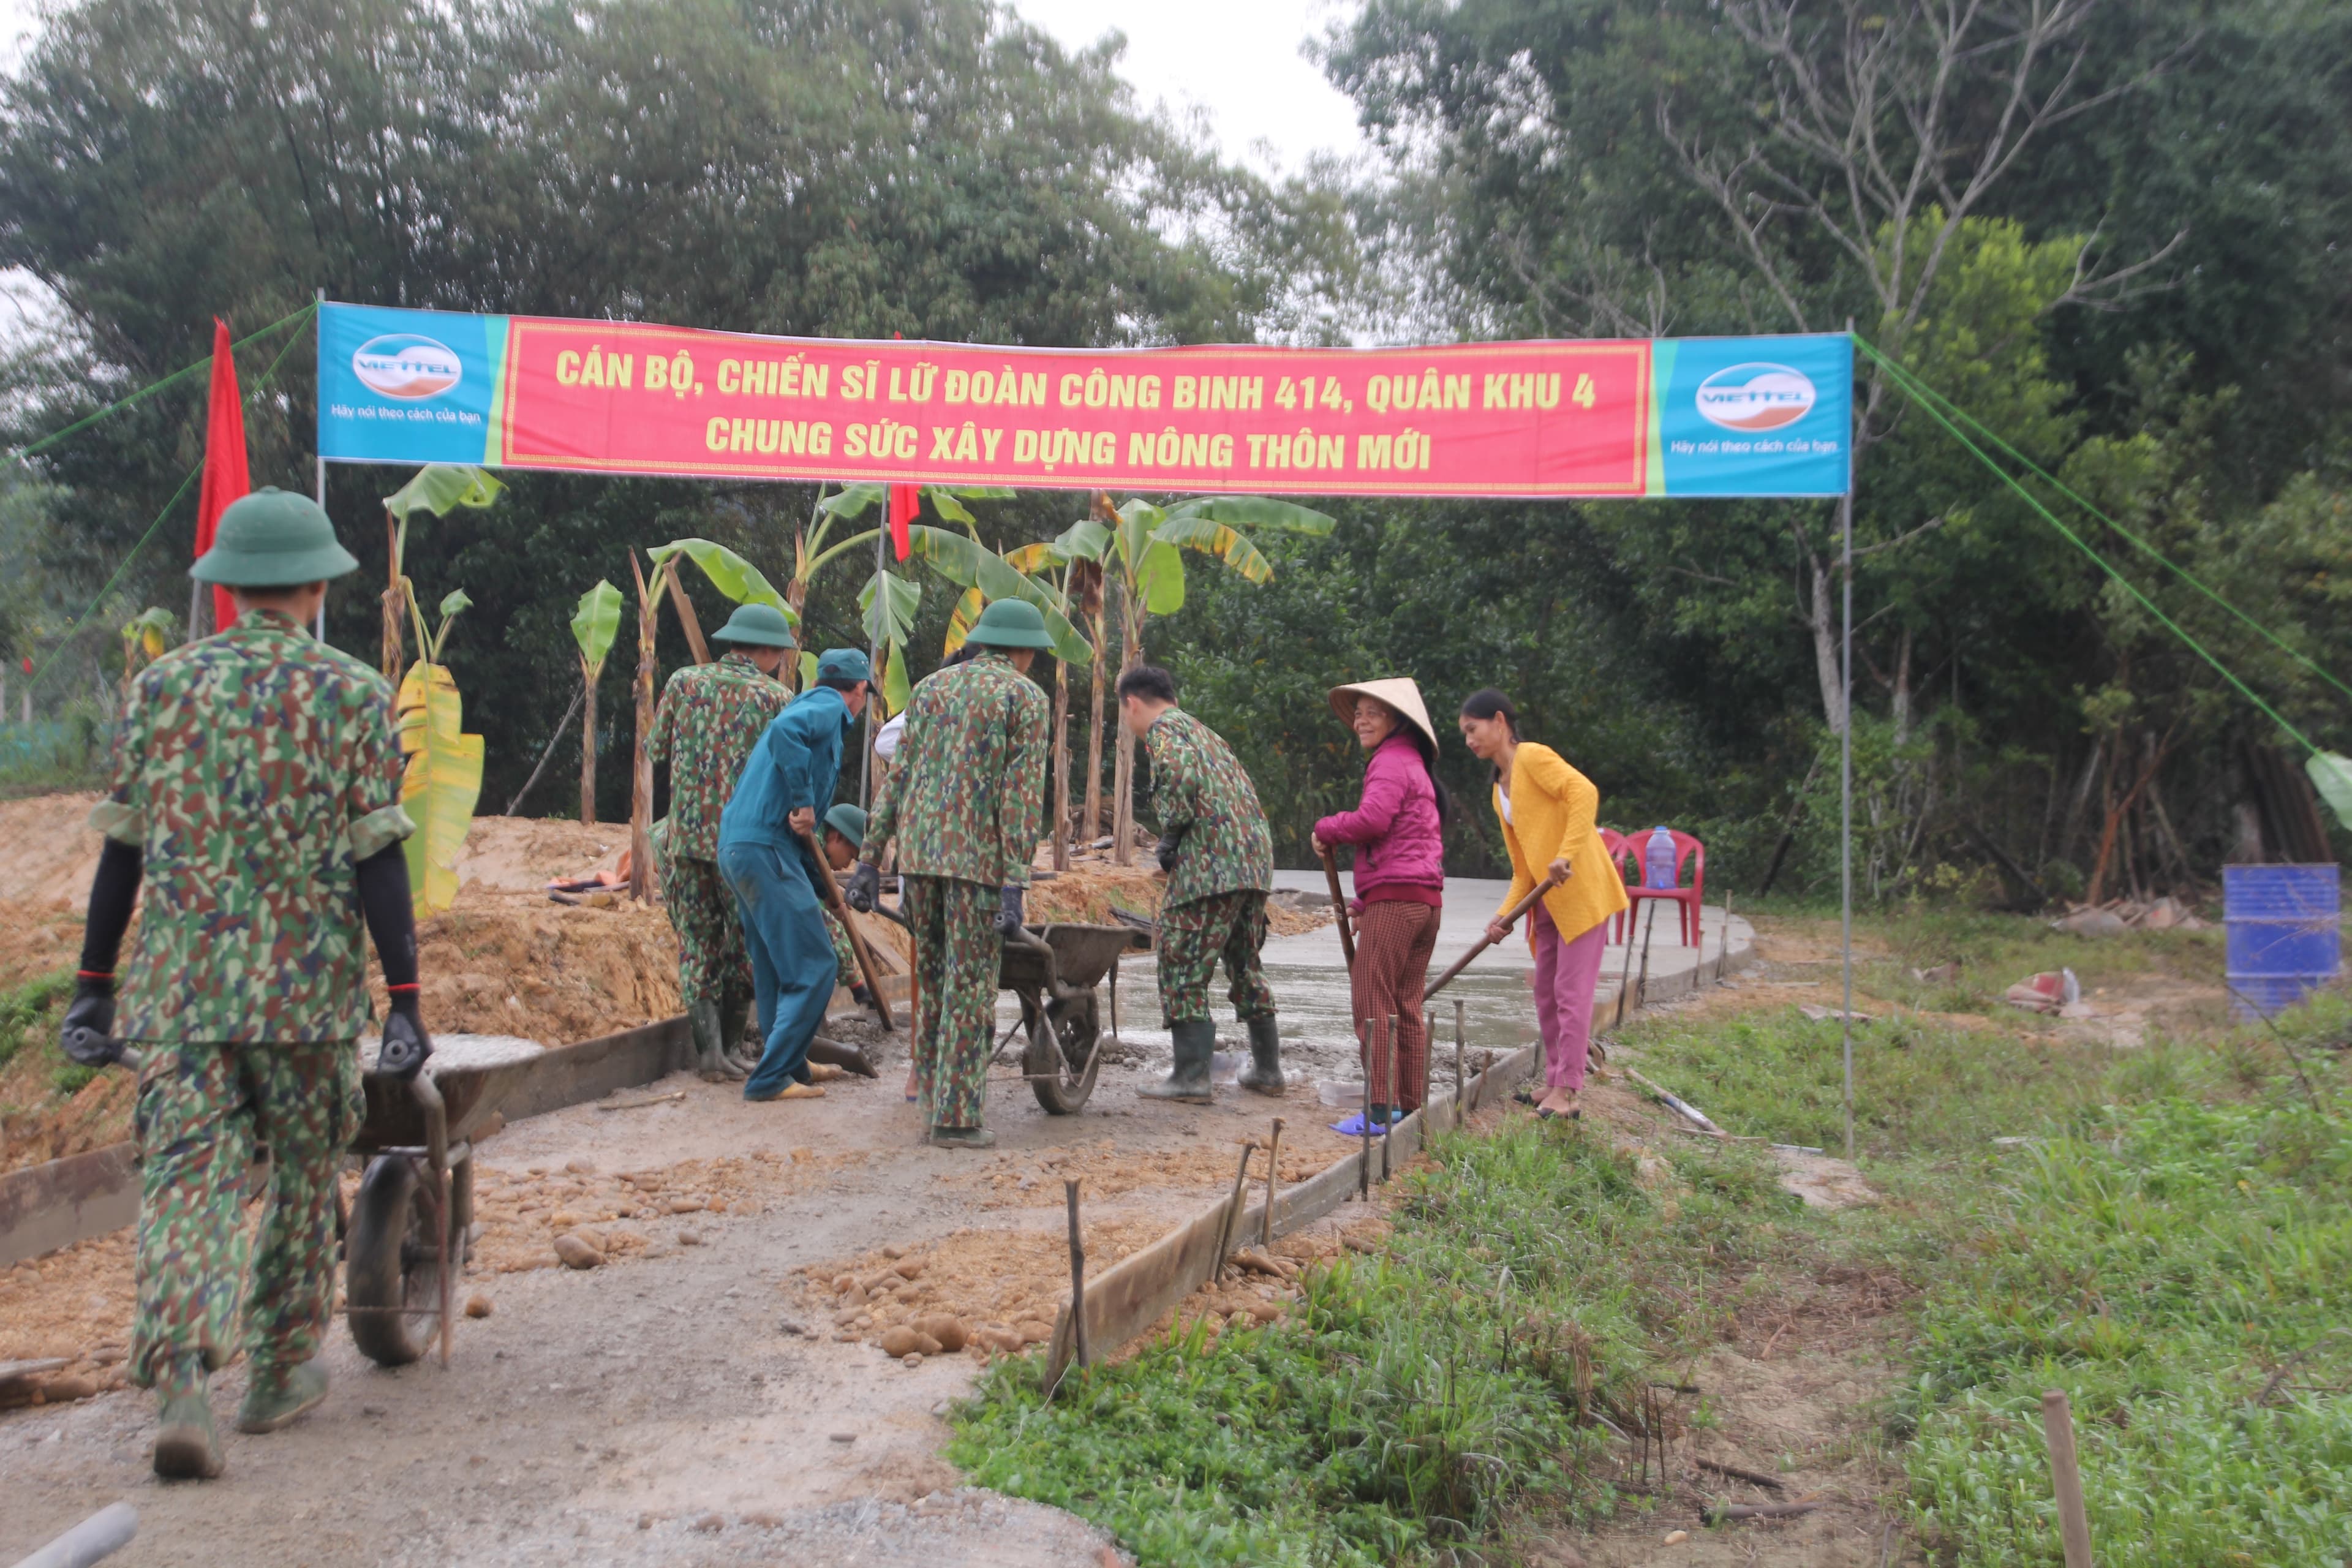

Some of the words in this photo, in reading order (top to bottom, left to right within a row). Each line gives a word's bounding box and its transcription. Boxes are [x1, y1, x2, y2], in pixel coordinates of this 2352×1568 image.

[358, 359, 458, 374] VIETTEL
[556, 344, 634, 388] CÁN
[644, 349, 704, 398] BỘ,
[717, 352, 829, 398] CHIẾN
[840, 360, 881, 401] SĨ
[888, 361, 938, 402] LỮ
[944, 364, 1047, 406] ĐOÀN
[1059, 367, 1161, 409] CÔNG
[1172, 375, 1264, 410] BINH
[1274, 375, 1353, 415] 414,
[1366, 367, 1471, 414] QUÂN
[1483, 372, 1561, 410] KHU
[1572, 373, 1596, 409] 4
[1703, 391, 1809, 404] VIETTEL
[331, 404, 354, 417] Hãy
[358, 405, 375, 417] nói
[378, 407, 405, 418] theo
[407, 408, 433, 421] cách
[435, 409, 456, 422] của
[459, 410, 481, 426] bạn
[706, 417, 832, 456] CHUNG
[843, 418, 919, 460] SỨC
[929, 421, 1004, 463] XÂY
[1013, 427, 1117, 471] DỰNG
[1128, 426, 1234, 469] NÔNG
[1246, 427, 1345, 470] THÔN
[1357, 427, 1431, 470] MỚI
